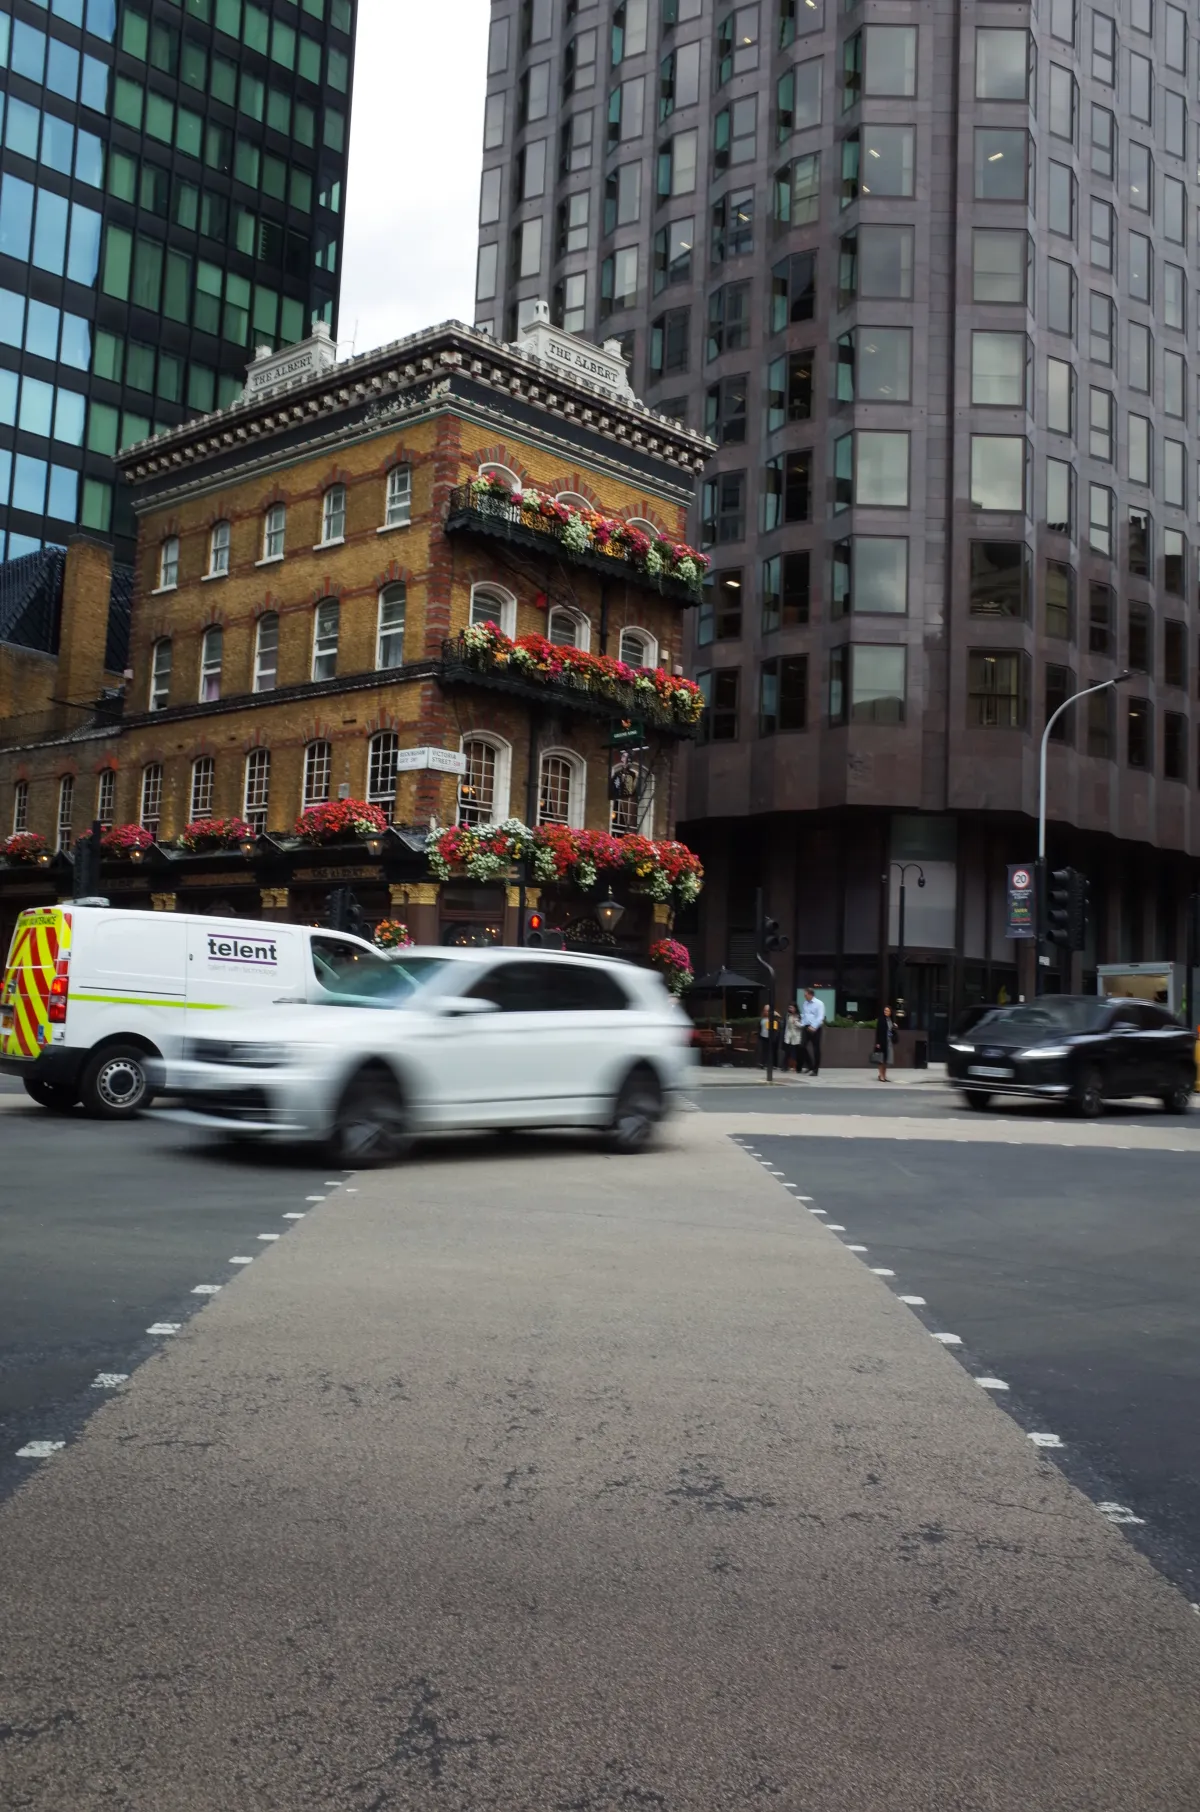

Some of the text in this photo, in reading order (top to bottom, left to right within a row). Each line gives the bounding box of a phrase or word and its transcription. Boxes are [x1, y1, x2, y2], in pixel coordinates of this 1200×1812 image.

[254, 355, 313, 386] THE ALBERT
[548, 342, 618, 383] THE ALBERT
[431, 756, 452, 766] STREET
[432, 750, 456, 759] VICTORIA
[1015, 874, 1027, 884] 20
[207, 938, 278, 961] telent
